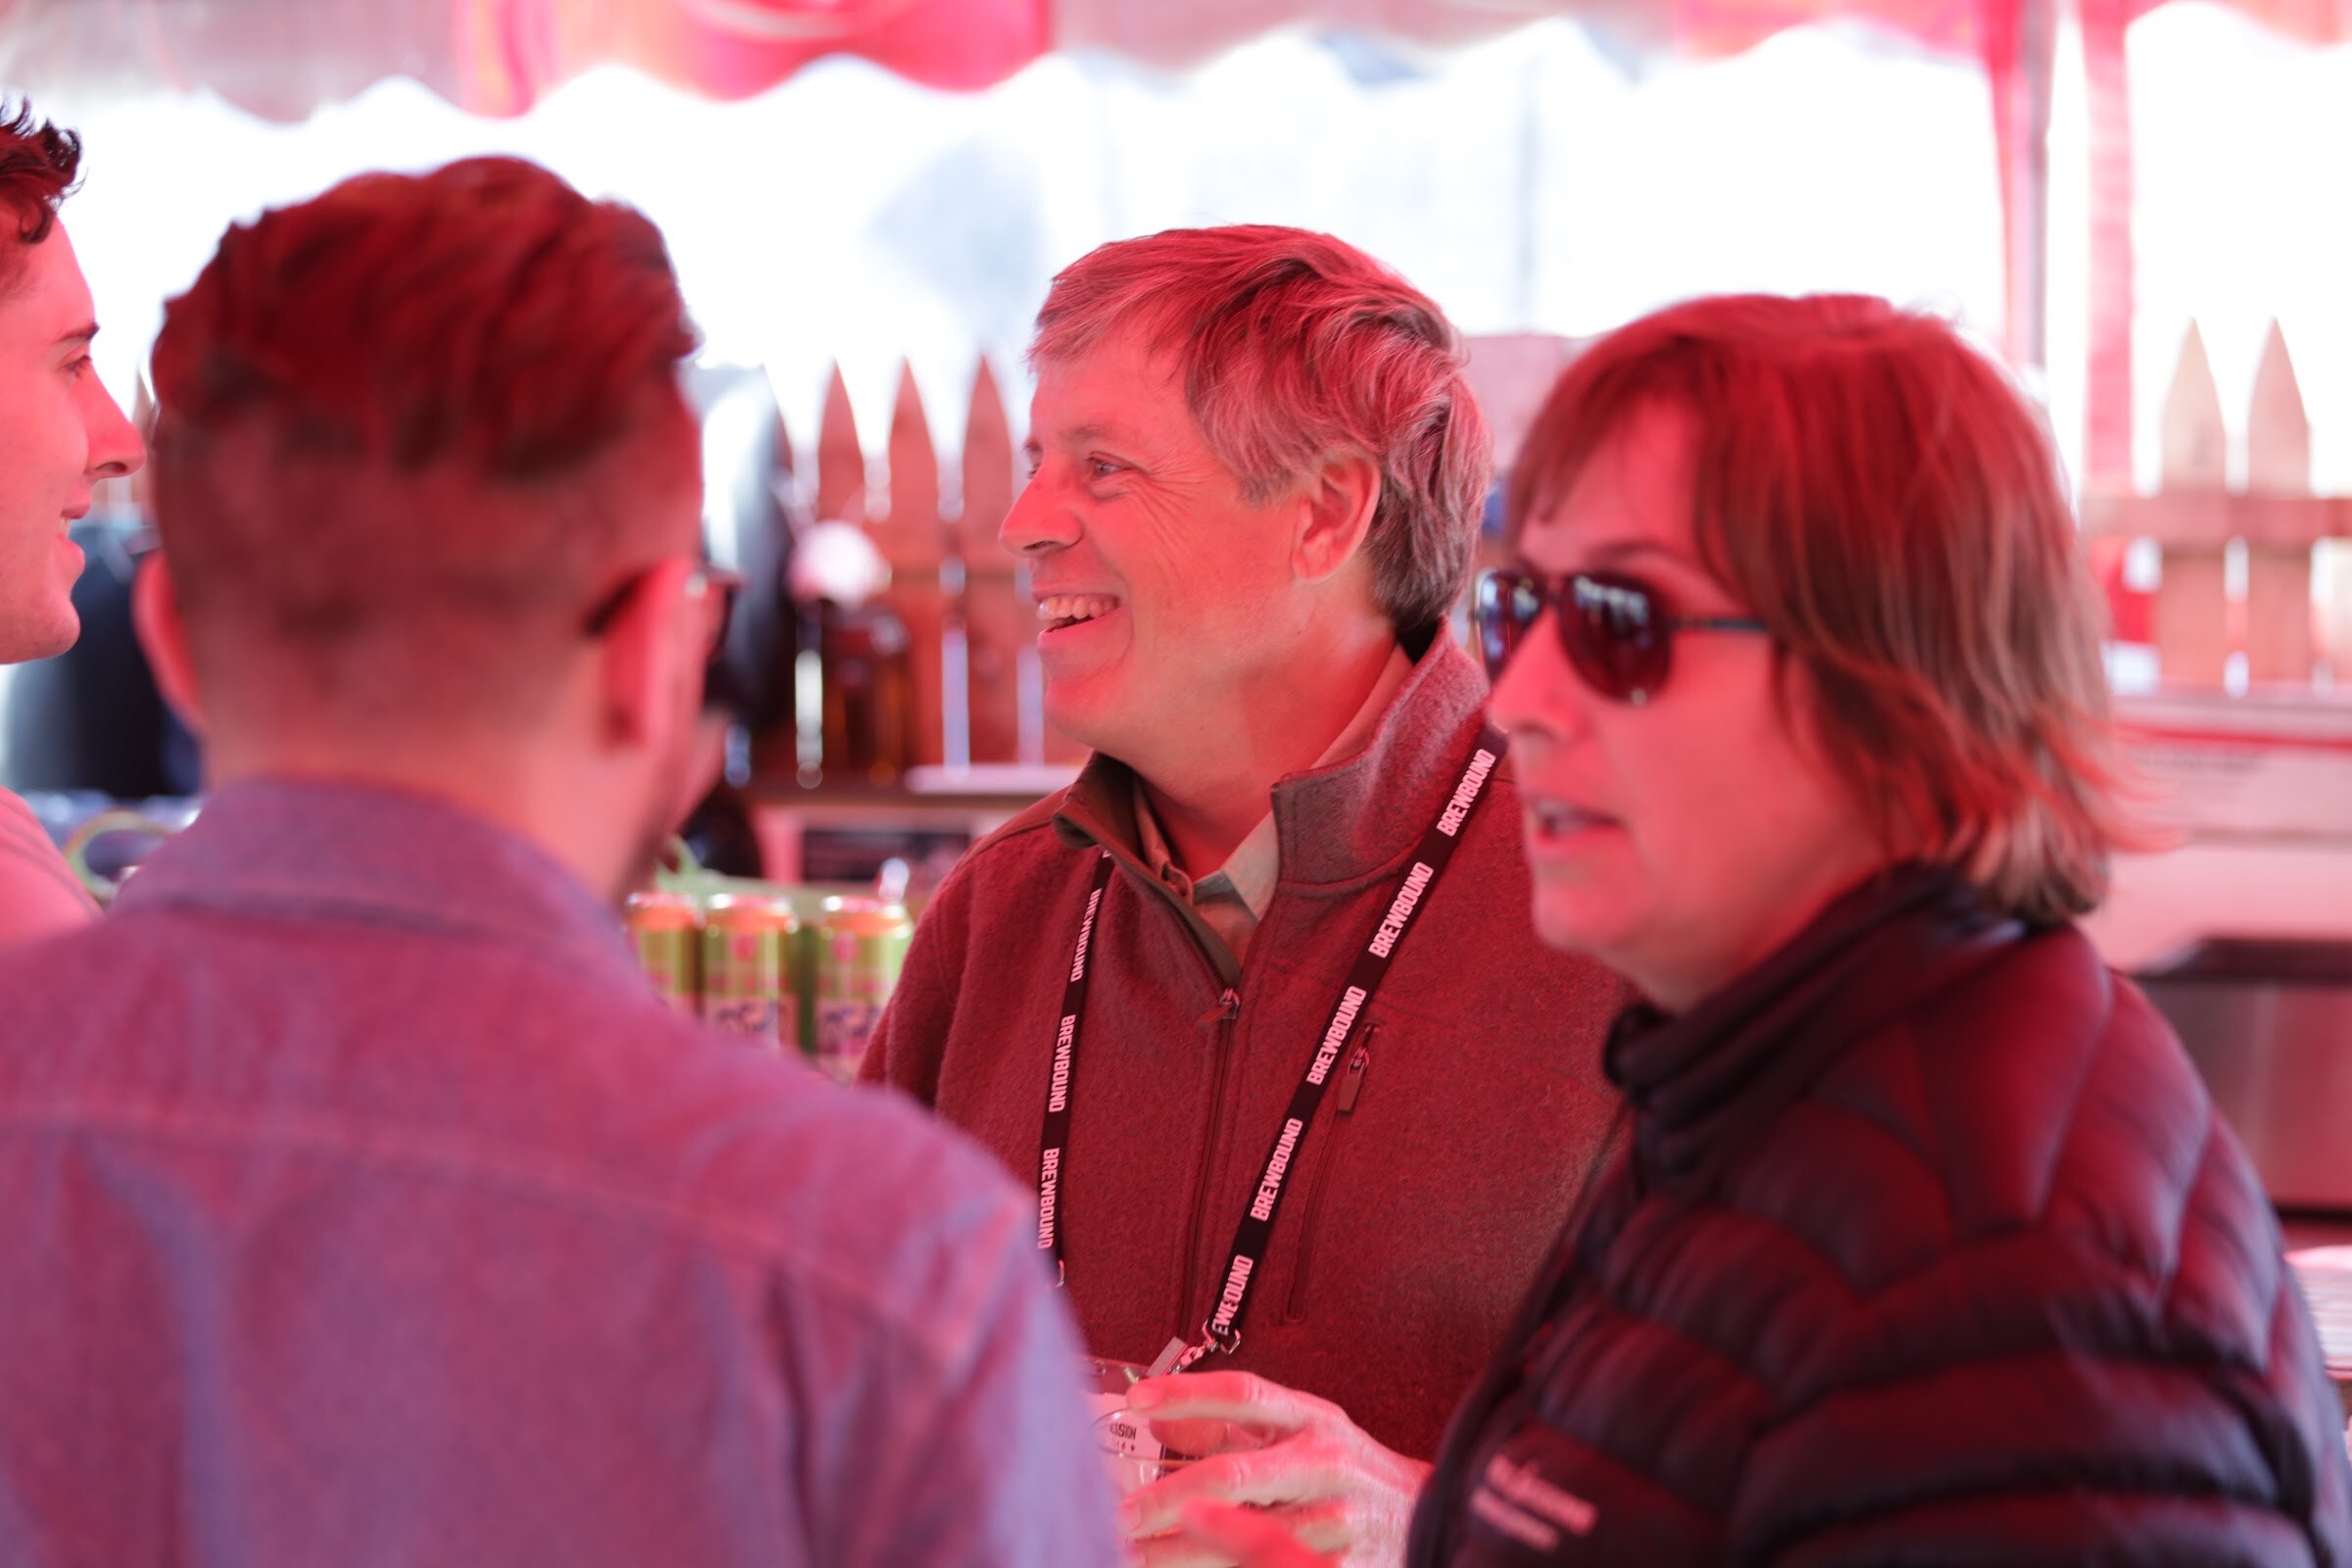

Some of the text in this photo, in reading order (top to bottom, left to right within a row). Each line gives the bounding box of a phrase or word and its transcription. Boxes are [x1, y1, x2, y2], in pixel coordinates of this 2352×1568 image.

[1437, 749, 1496, 837] BREWBOUND
[1368, 862, 1434, 958] BREWBOUND
[1049, 1014, 1076, 1112] BREWBOUND
[1306, 986, 1367, 1085] BREWBOUND
[1038, 1148, 1059, 1250] BREWBOUND
[1250, 1118, 1303, 1221] BREWBOUND
